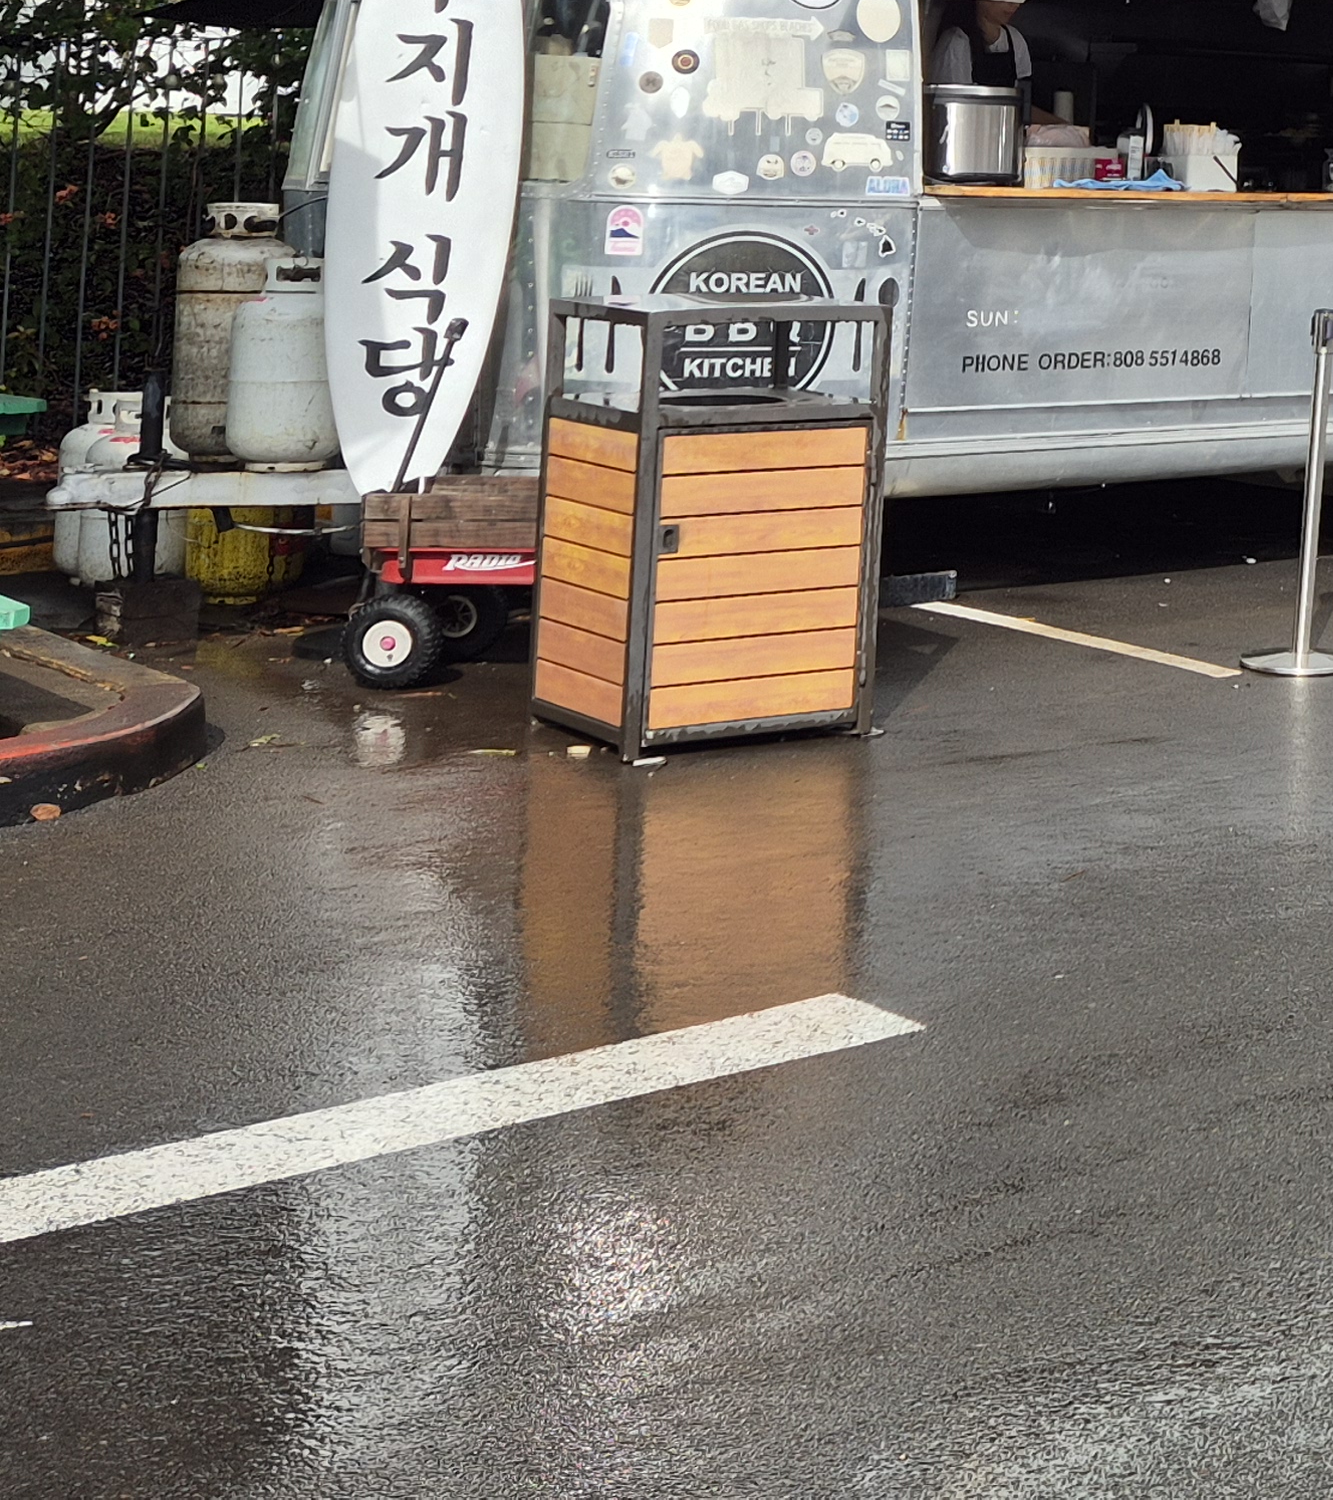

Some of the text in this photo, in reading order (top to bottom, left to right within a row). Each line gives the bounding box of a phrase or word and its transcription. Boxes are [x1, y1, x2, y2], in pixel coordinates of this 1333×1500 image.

[688, 271, 803, 294] KOREAN
[361, 233, 456, 417] 식당
[962, 353, 1030, 373] PHONE
[1148, 348, 1222, 367] 5514868
